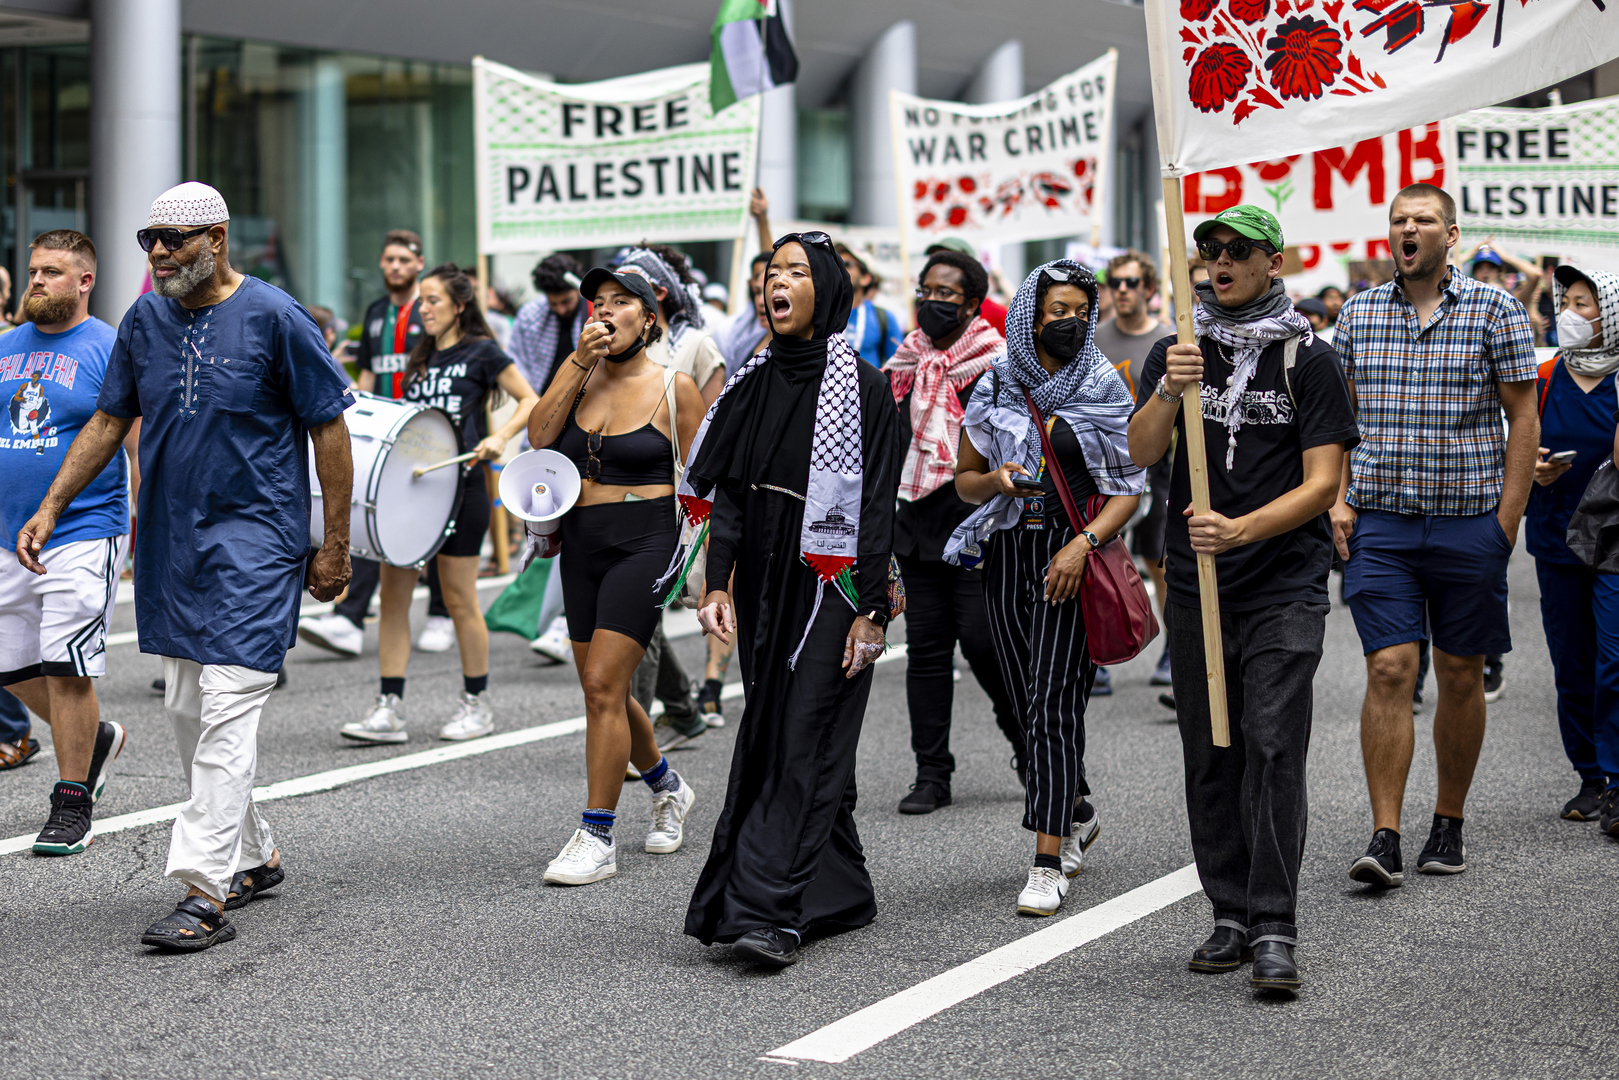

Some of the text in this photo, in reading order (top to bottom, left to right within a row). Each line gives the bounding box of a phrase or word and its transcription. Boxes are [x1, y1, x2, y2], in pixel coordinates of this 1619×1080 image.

[561, 95, 690, 138] FREE
[904, 107, 940, 128] NO
[909, 110, 1103, 165] WAR CRIME
[1456, 127, 1570, 159] FREE
[507, 151, 742, 205] PALESTINE
[443, 363, 467, 377] IN
[1218, 387, 1276, 402] AGELES
[42, 426, 58, 436] 76
[827, 541, 846, 550] القدس
[60, 788, 81, 796] JORDAN
